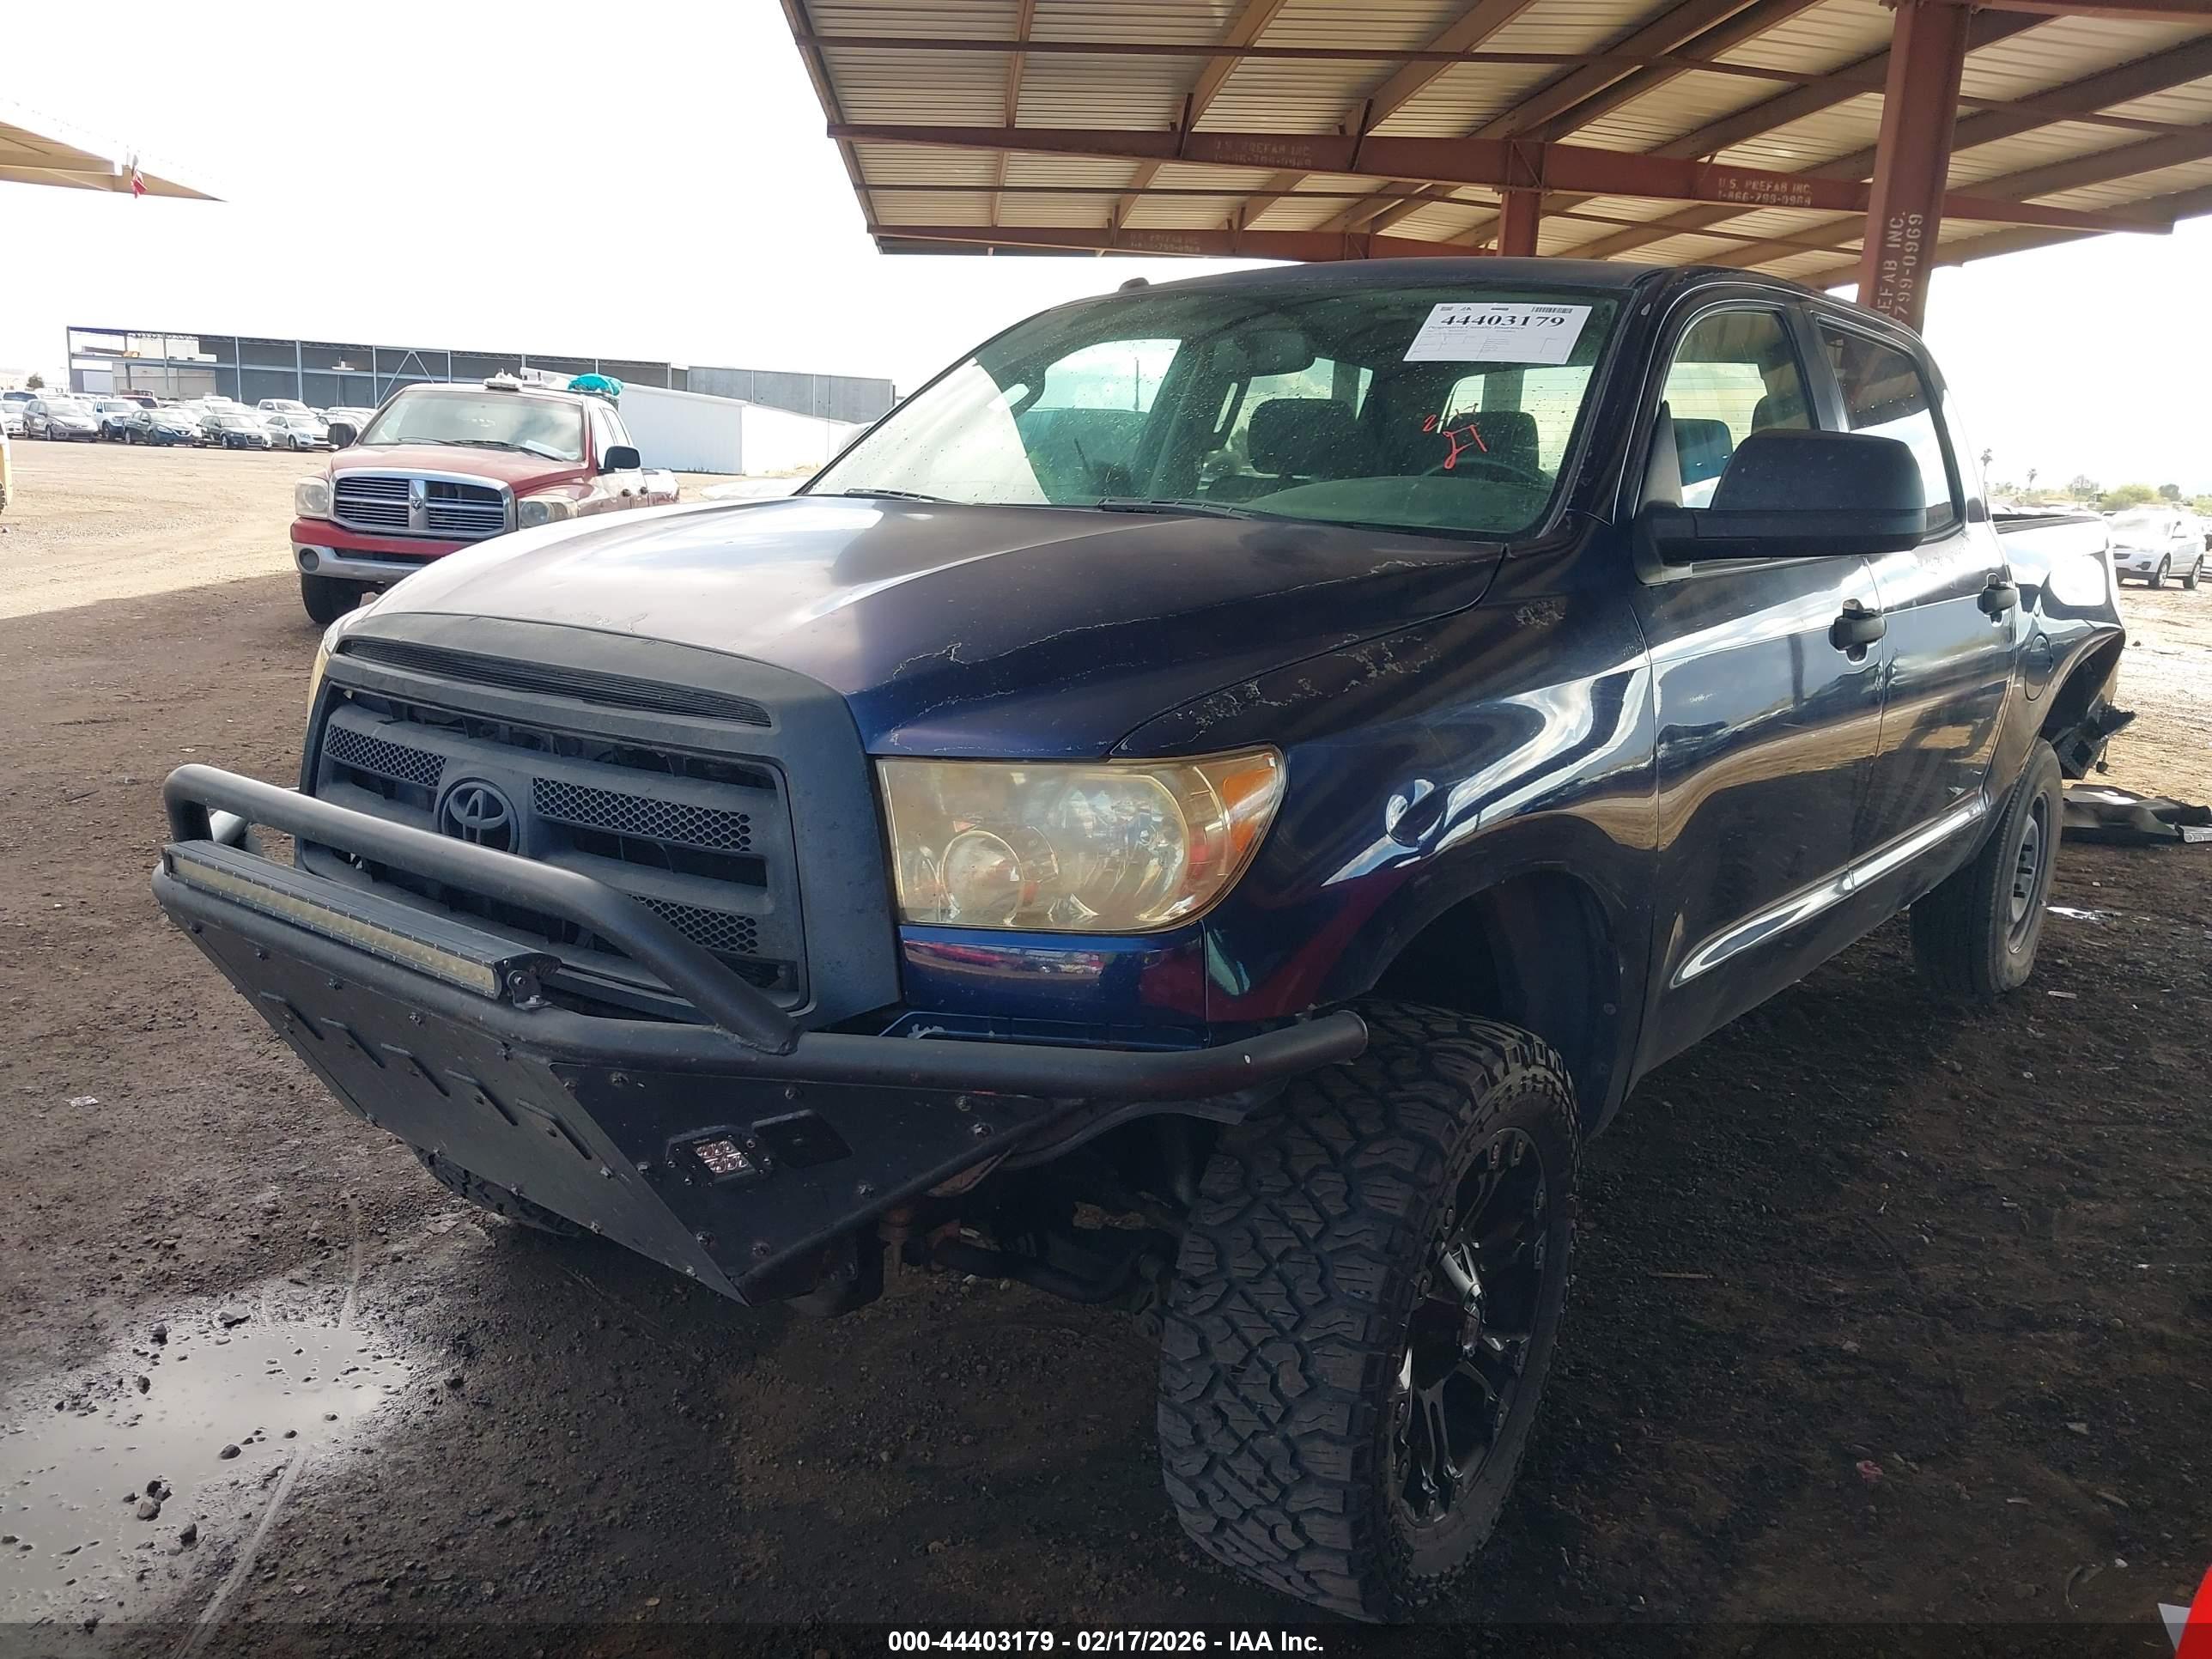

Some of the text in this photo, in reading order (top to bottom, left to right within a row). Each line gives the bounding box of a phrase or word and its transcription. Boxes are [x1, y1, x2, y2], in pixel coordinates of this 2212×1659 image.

[1744, 179, 1788, 193] PREFAB
[1792, 183, 1814, 196] INC.
[1886, 210, 1906, 249] INC.
[1440, 314, 1566, 327] 44403179
